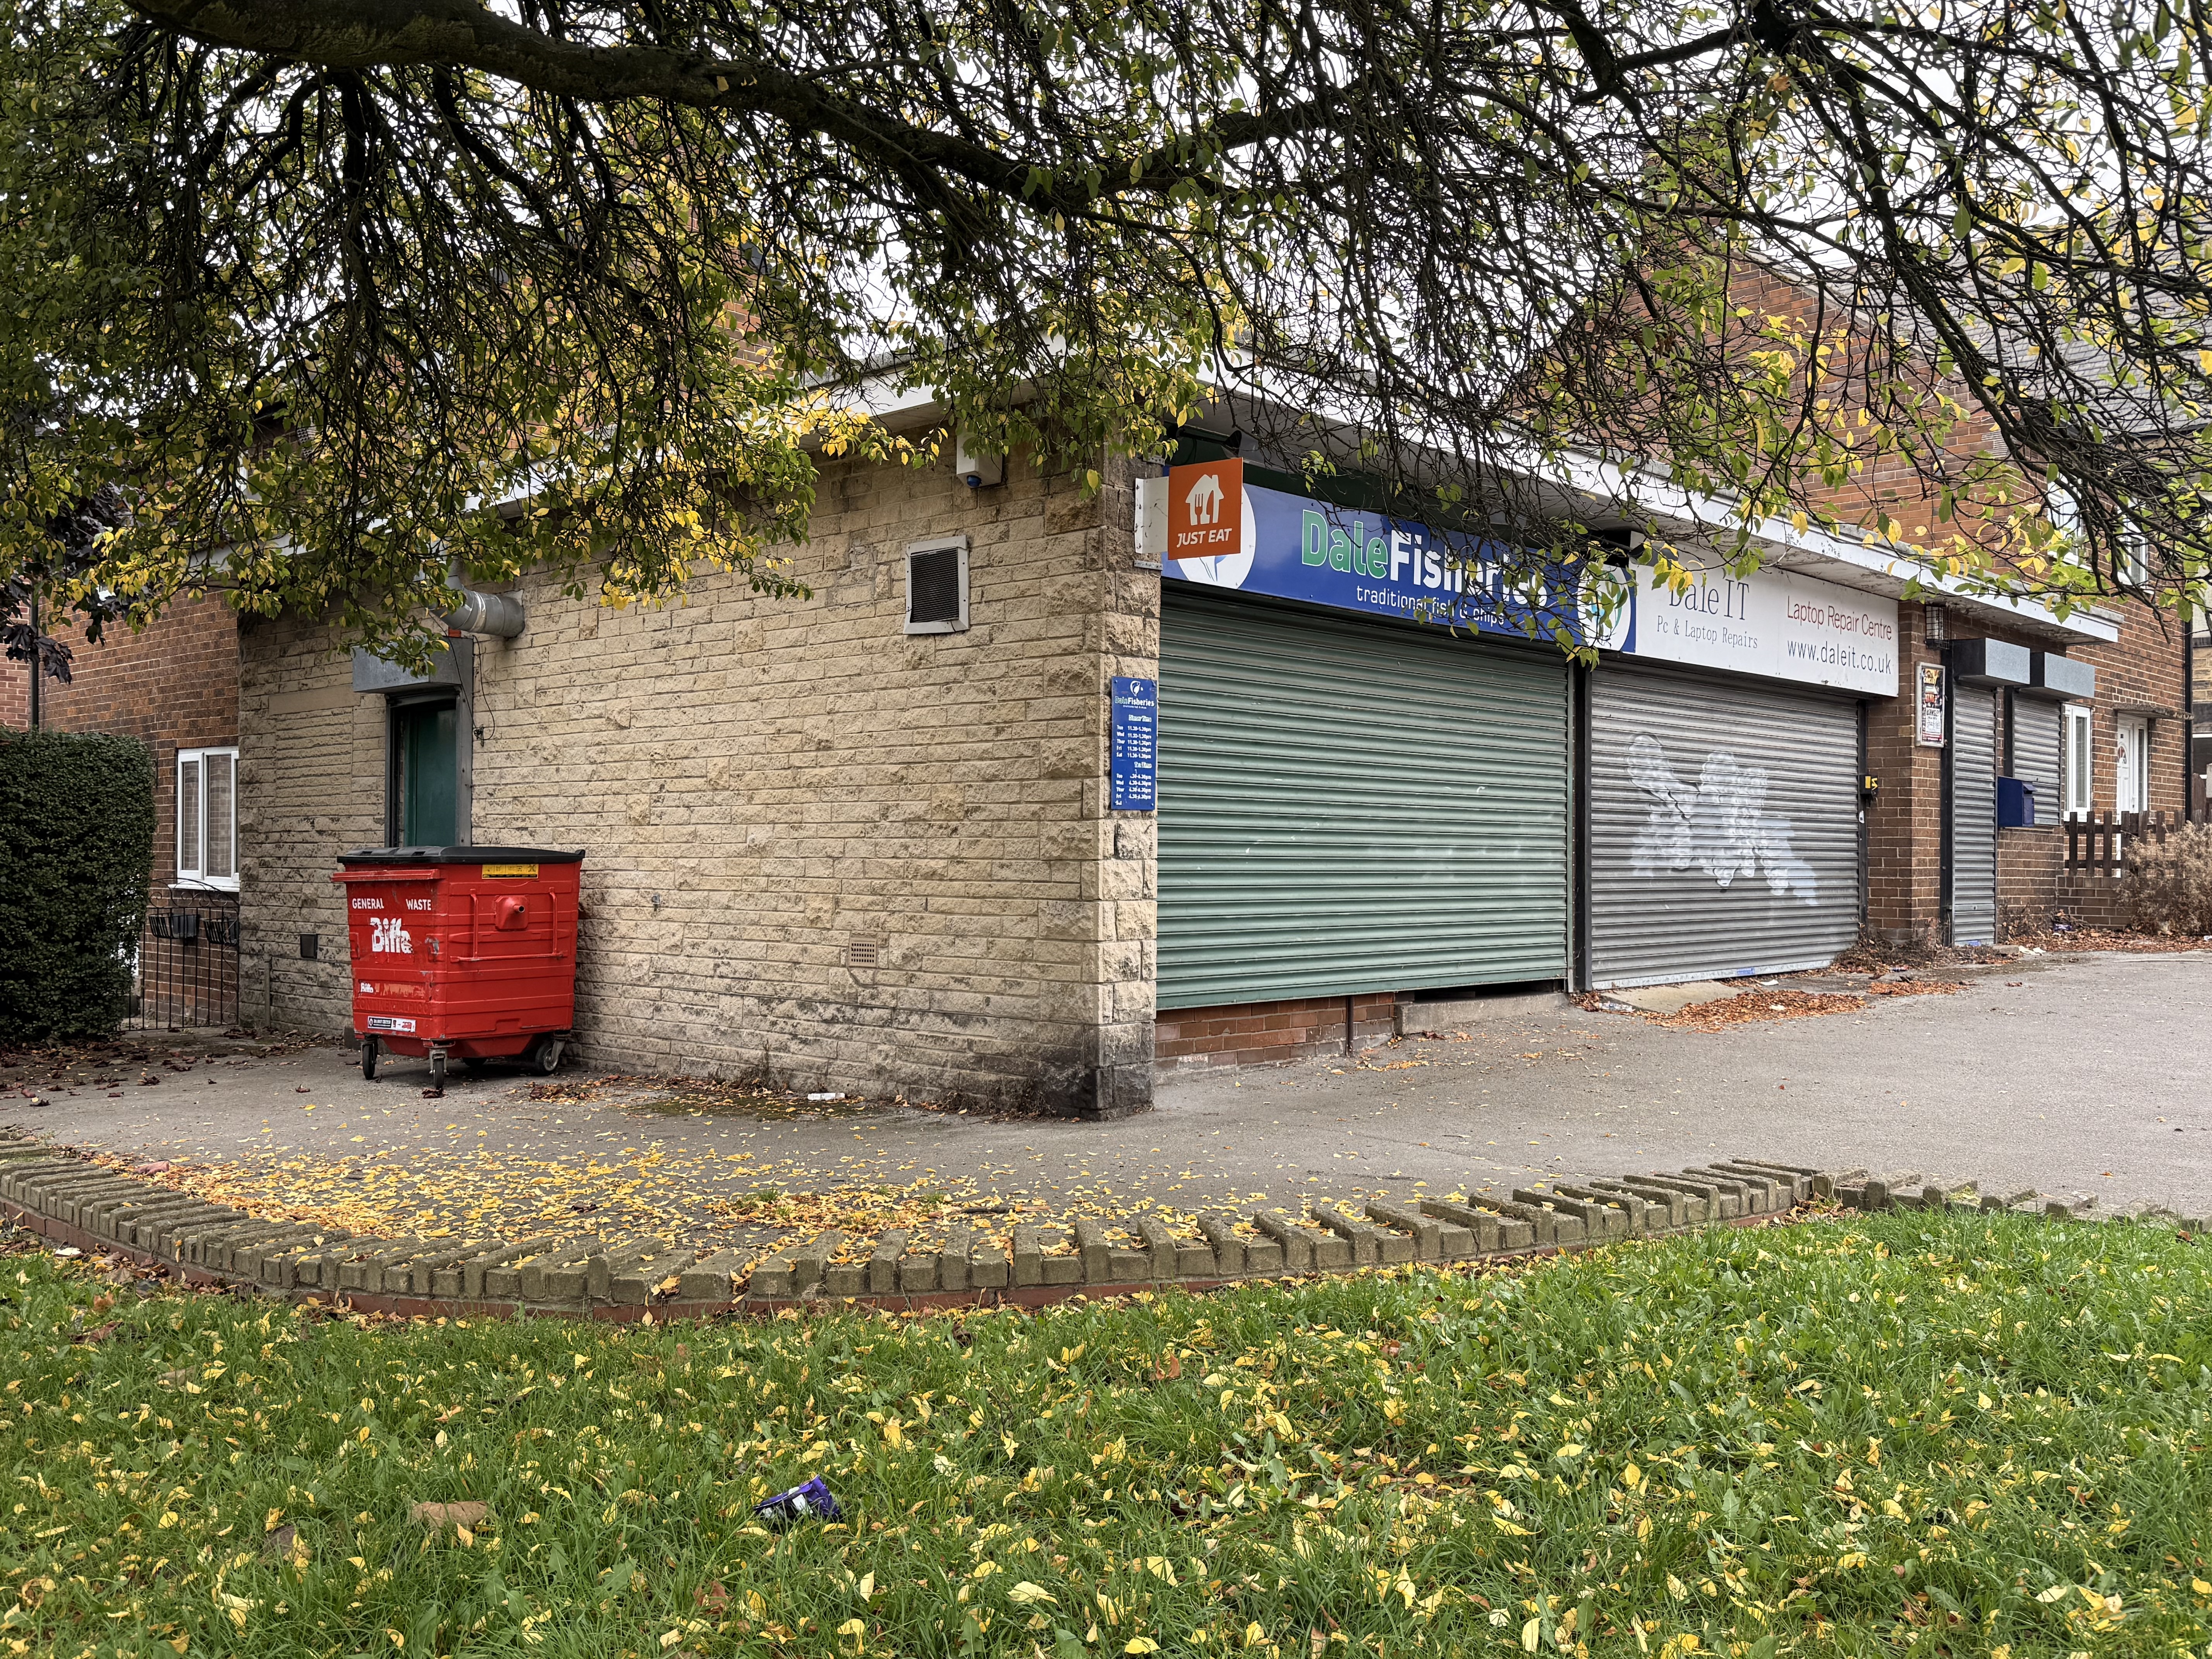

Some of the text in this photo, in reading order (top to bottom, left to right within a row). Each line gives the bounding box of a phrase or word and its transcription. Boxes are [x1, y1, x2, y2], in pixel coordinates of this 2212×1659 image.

[1176, 528, 1232, 548] JUST EAT
[1357, 585, 1427, 611] traditional
[1724, 579, 1750, 620] IT
[1657, 615, 1758, 649] Pc & Laptop Repairs
[1788, 595, 1892, 641] Laptop Repair Centre
[1788, 640, 1891, 675] www.daleit.co.uk
[1115, 696, 1154, 707] DaleFisheries
[352, 898, 432, 910] GENERAL WASTE
